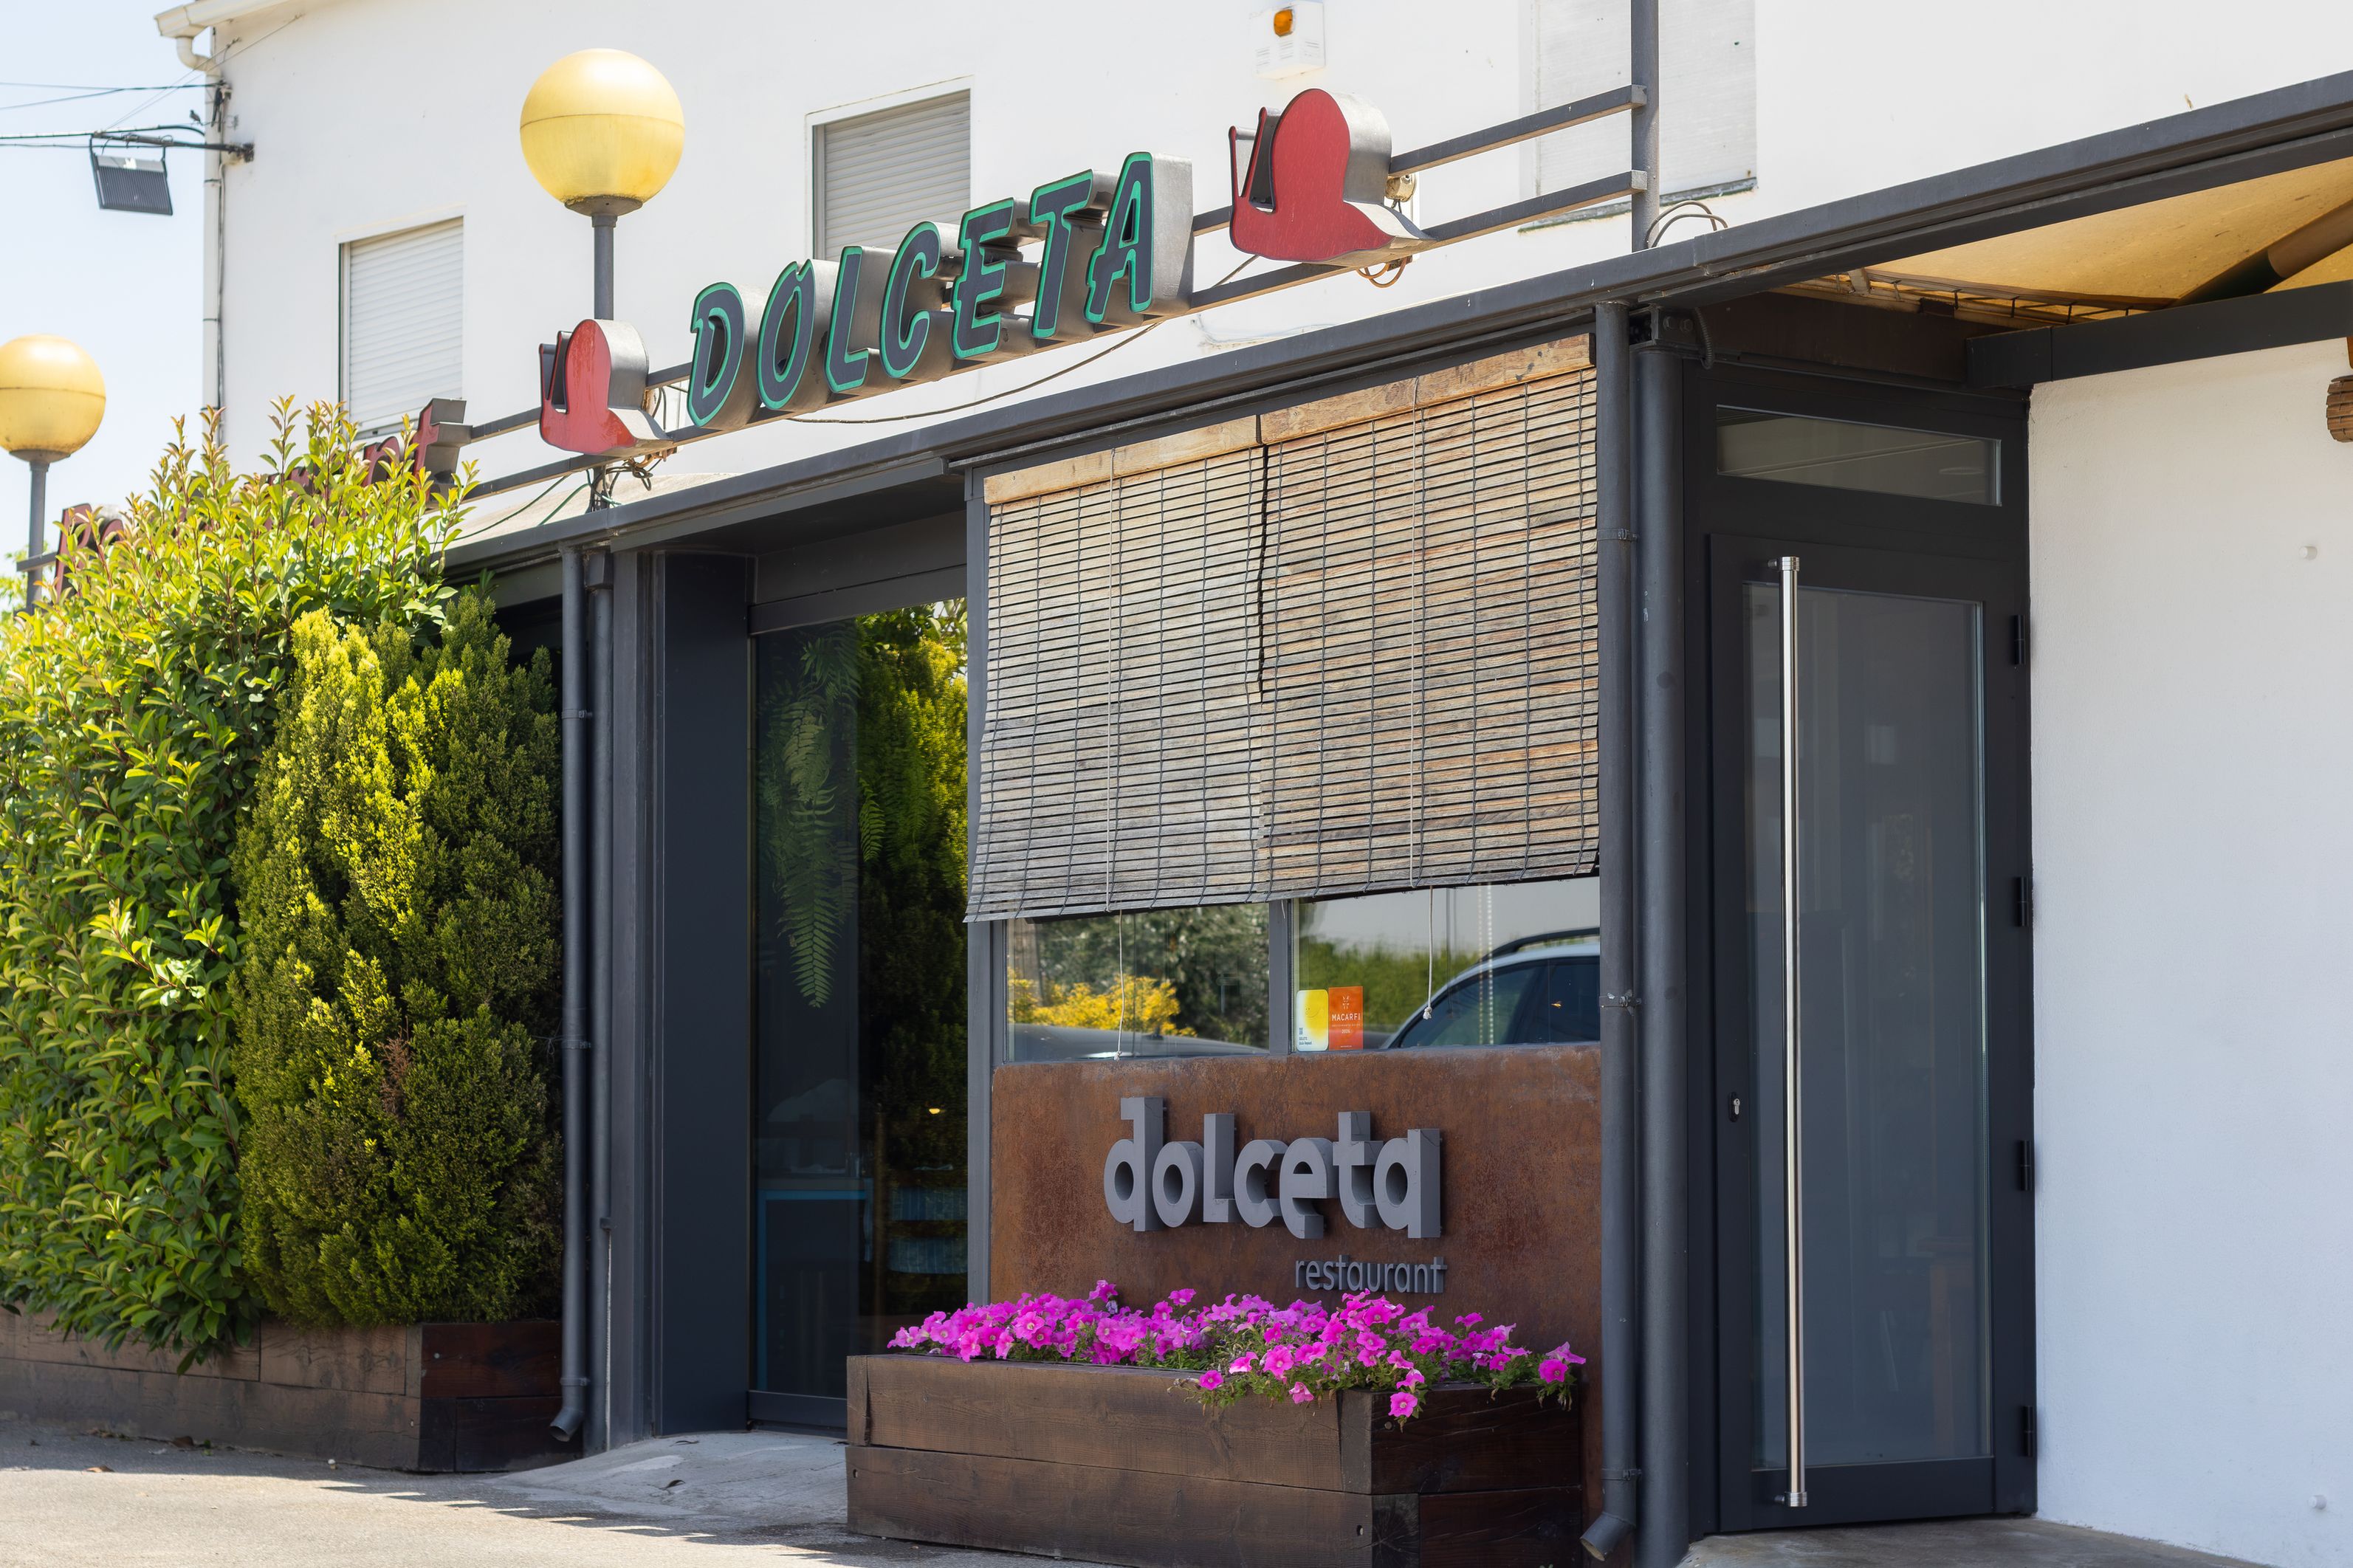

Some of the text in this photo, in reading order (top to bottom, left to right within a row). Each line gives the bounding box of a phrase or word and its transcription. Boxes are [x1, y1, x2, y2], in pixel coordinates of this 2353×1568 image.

[686, 151, 1155, 429] DOLCETA
[1104, 1096, 1440, 1239] dolceta
[1295, 1256, 1447, 1293] restaurant
